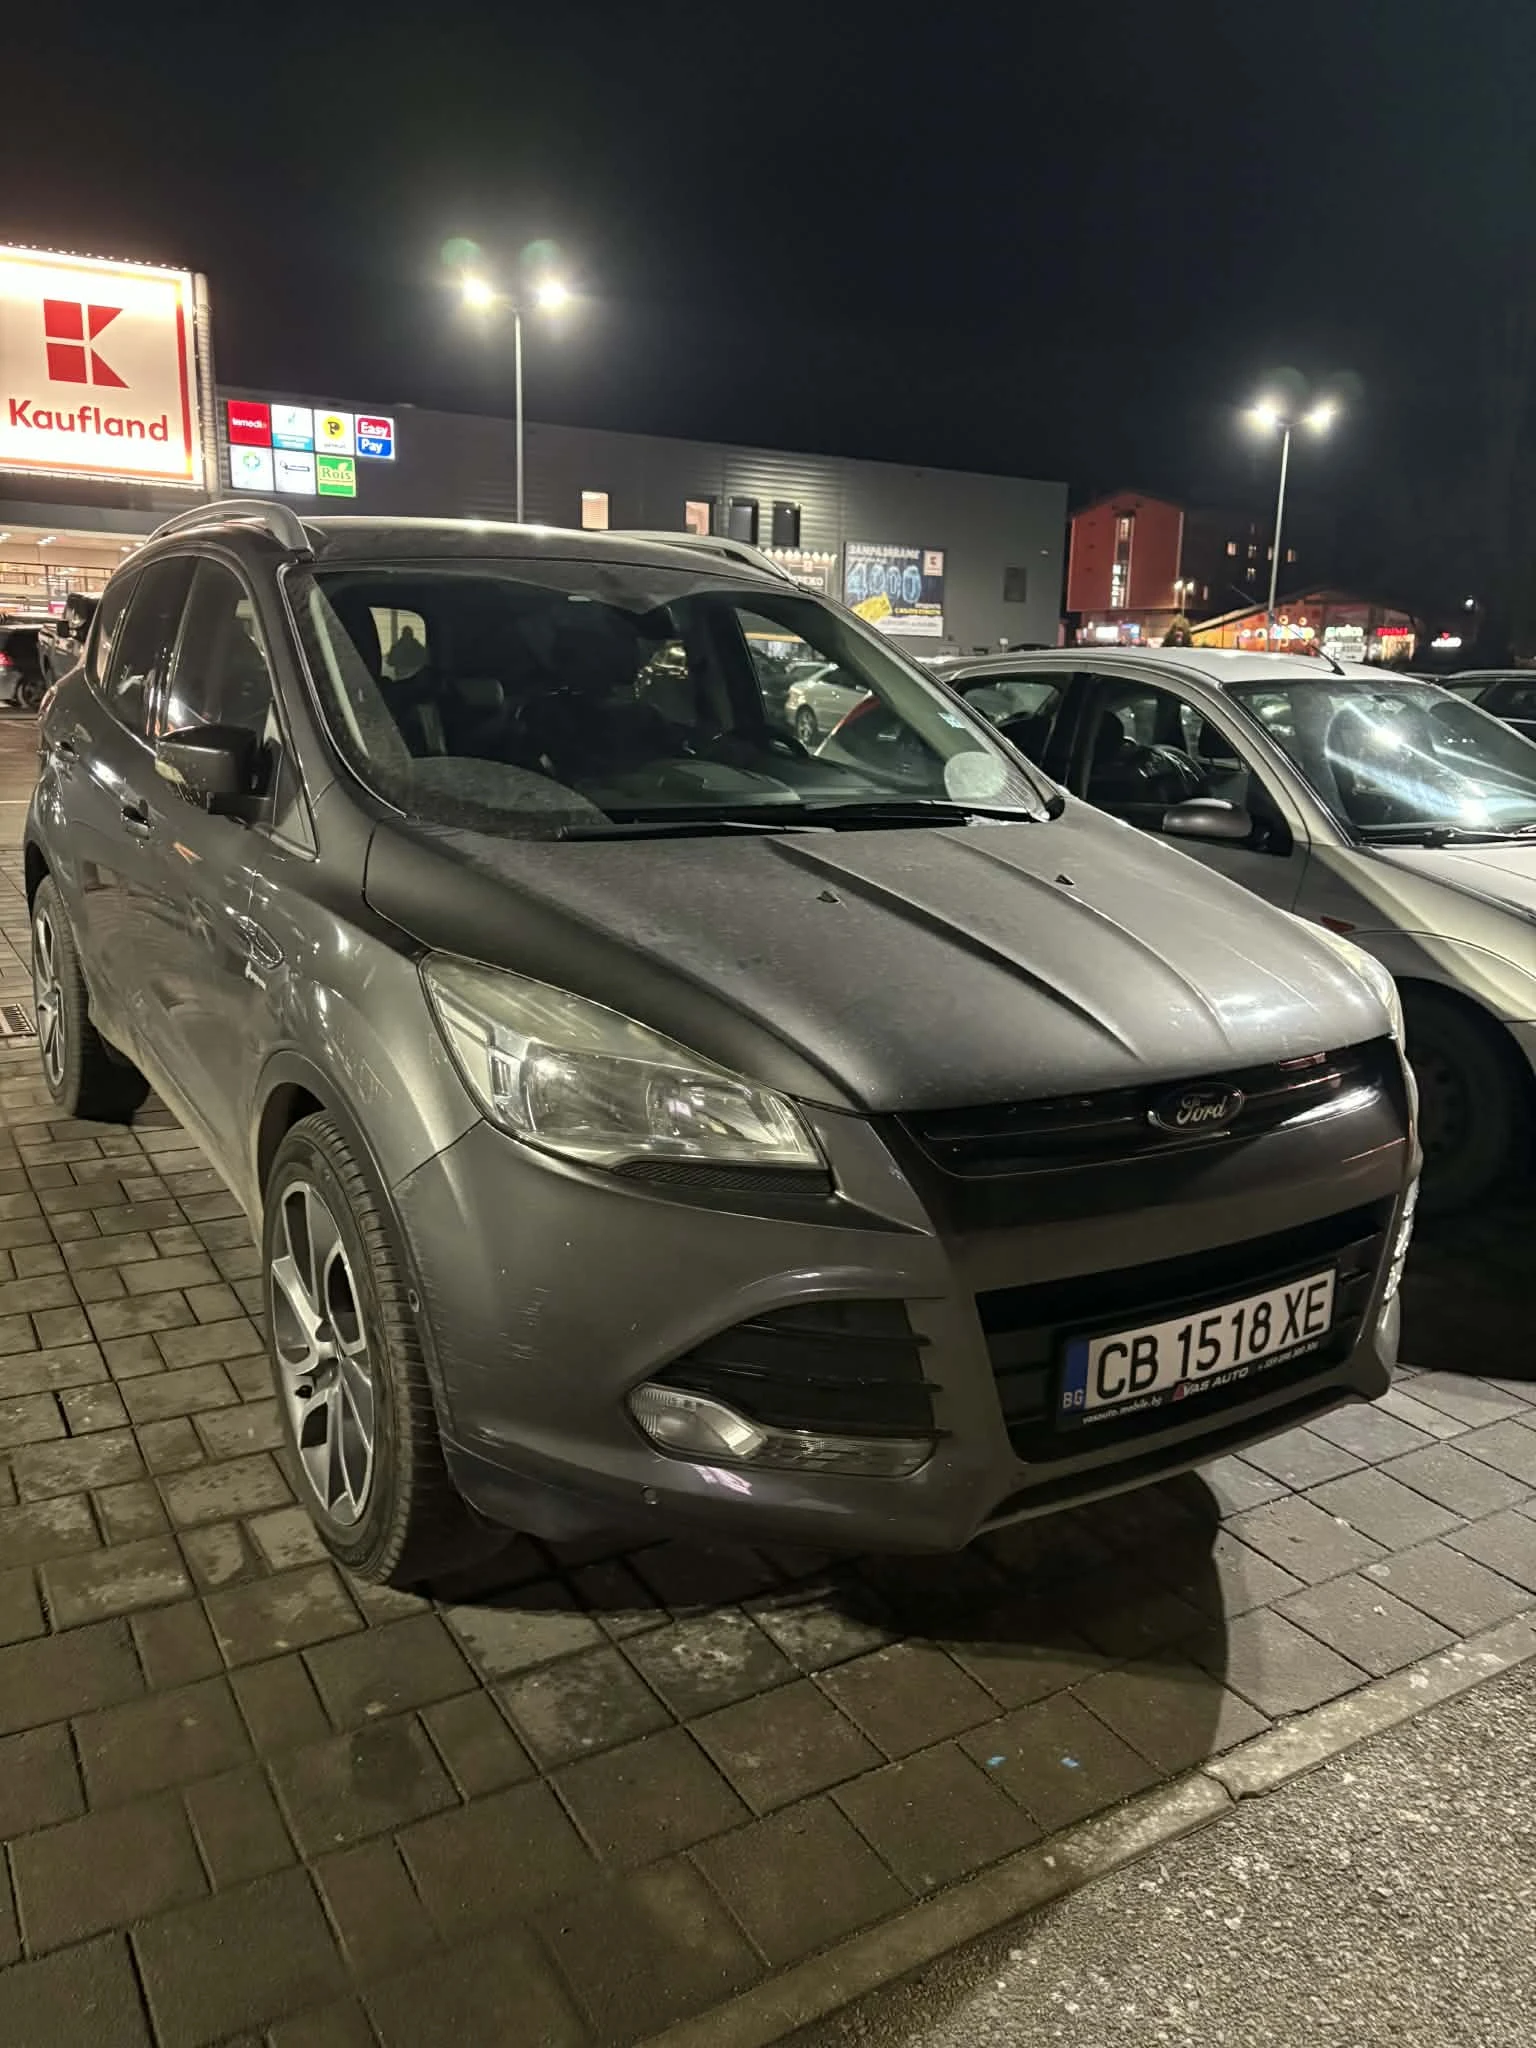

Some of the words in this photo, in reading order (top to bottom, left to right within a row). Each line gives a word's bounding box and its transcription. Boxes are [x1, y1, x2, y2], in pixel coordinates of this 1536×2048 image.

[8, 398, 169, 441] Kaufland
[360, 421, 389, 437] Easy
[361, 439, 383, 454] Pay
[847, 562, 922, 604] 4000
[1176, 1093, 1228, 1125] Ford
[1096, 1335, 1158, 1399] CB
[1177, 1301, 1272, 1378] 1518
[1280, 1280, 1328, 1344] XE
[1211, 1367, 1249, 1387] AUTO
[1063, 1388, 1084, 1408] BG
